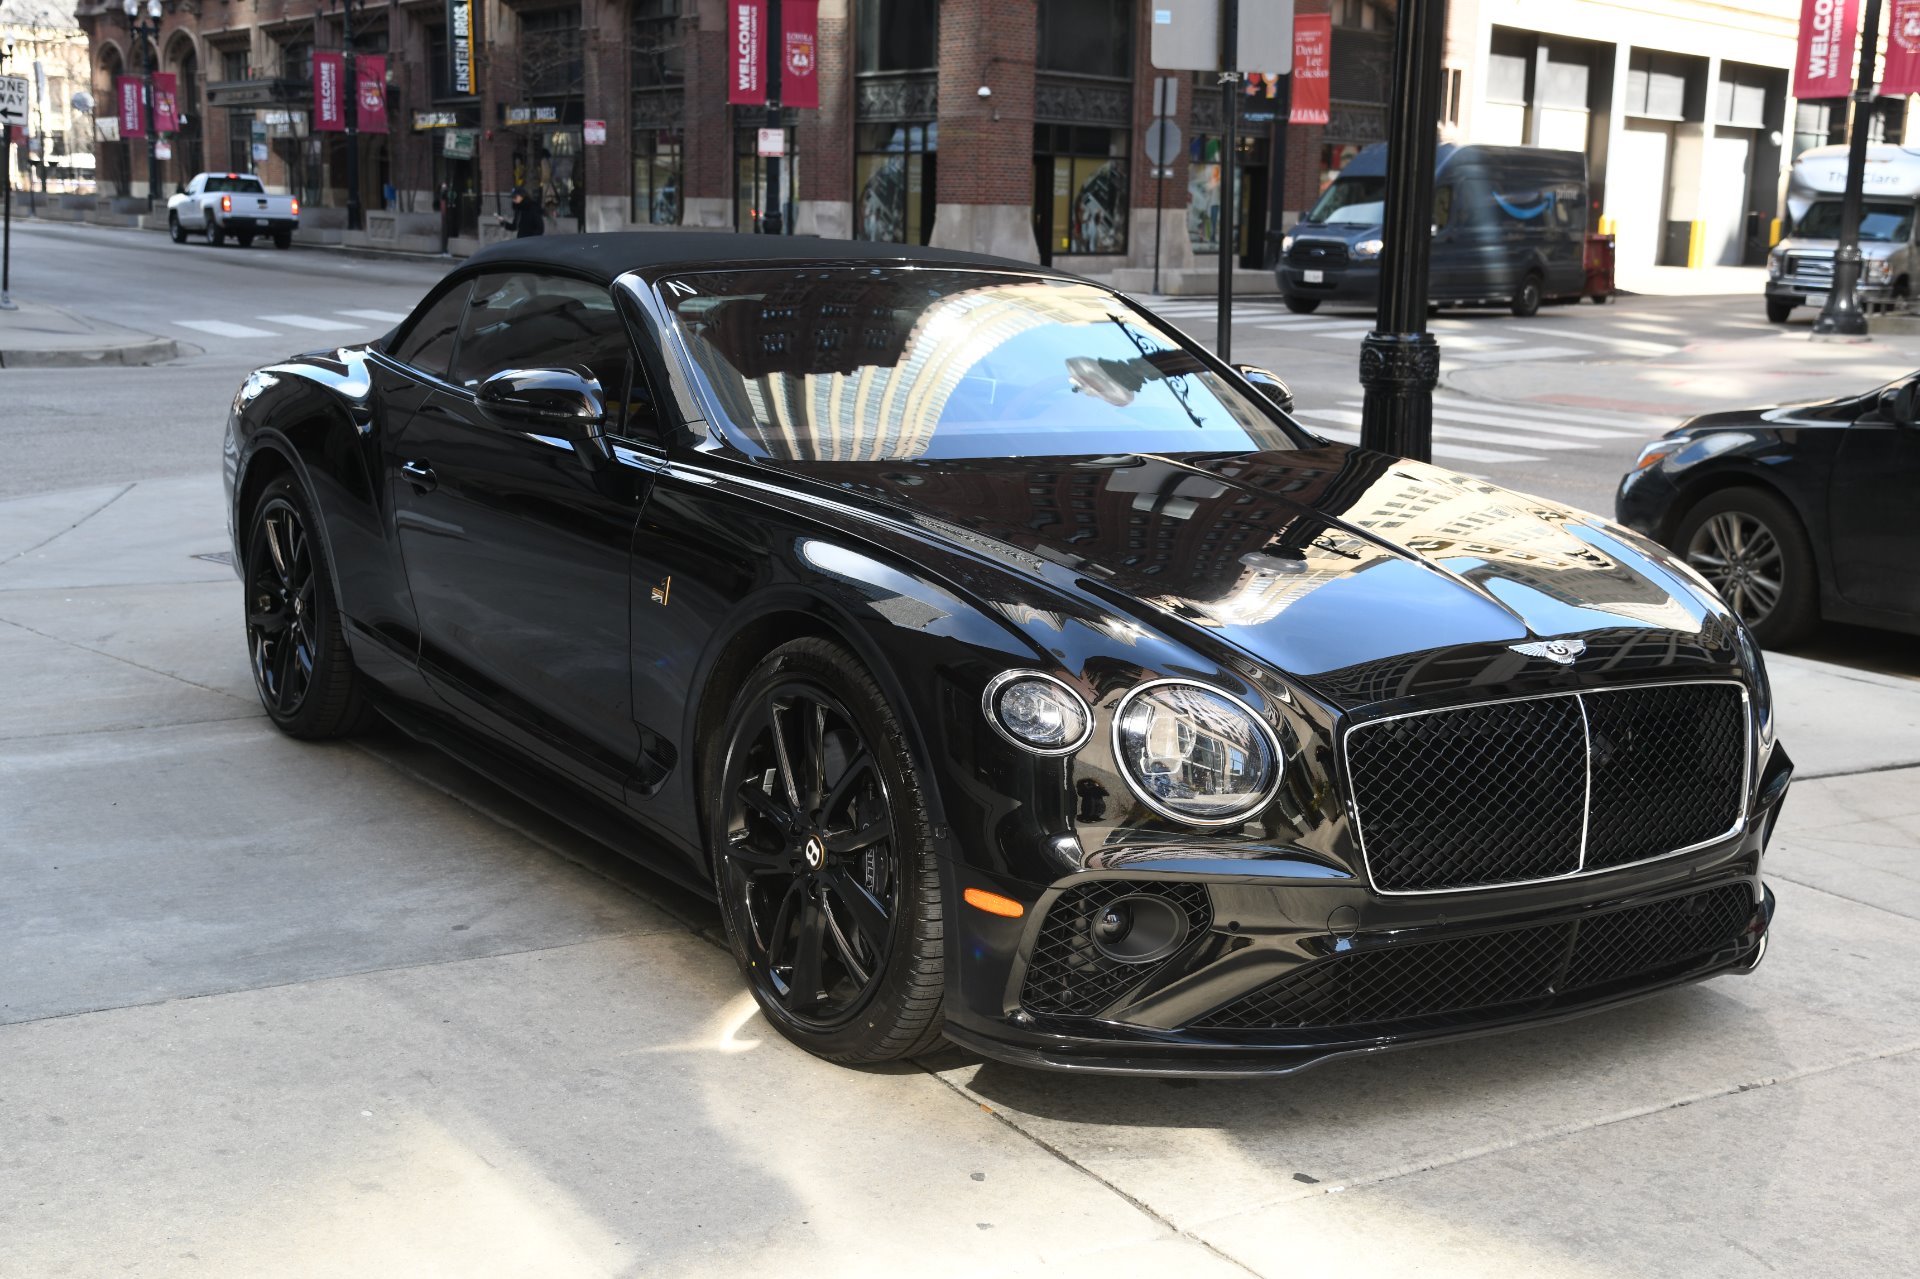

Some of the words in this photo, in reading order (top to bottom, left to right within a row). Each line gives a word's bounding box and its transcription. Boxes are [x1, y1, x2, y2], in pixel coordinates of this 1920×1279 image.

[1831, 7, 1844, 43] TOWER
[455, 38, 470, 92] EINSTEIN
[738, 5, 750, 90] WELCOME
[1295, 44, 1323, 56] David
[1306, 56, 1322, 67] Lee
[1828, 43, 1840, 79] WATER
[123, 84, 134, 131] WELCOME
[320, 62, 331, 121] WELCOME
[1829, 171, 1847, 183] Th
